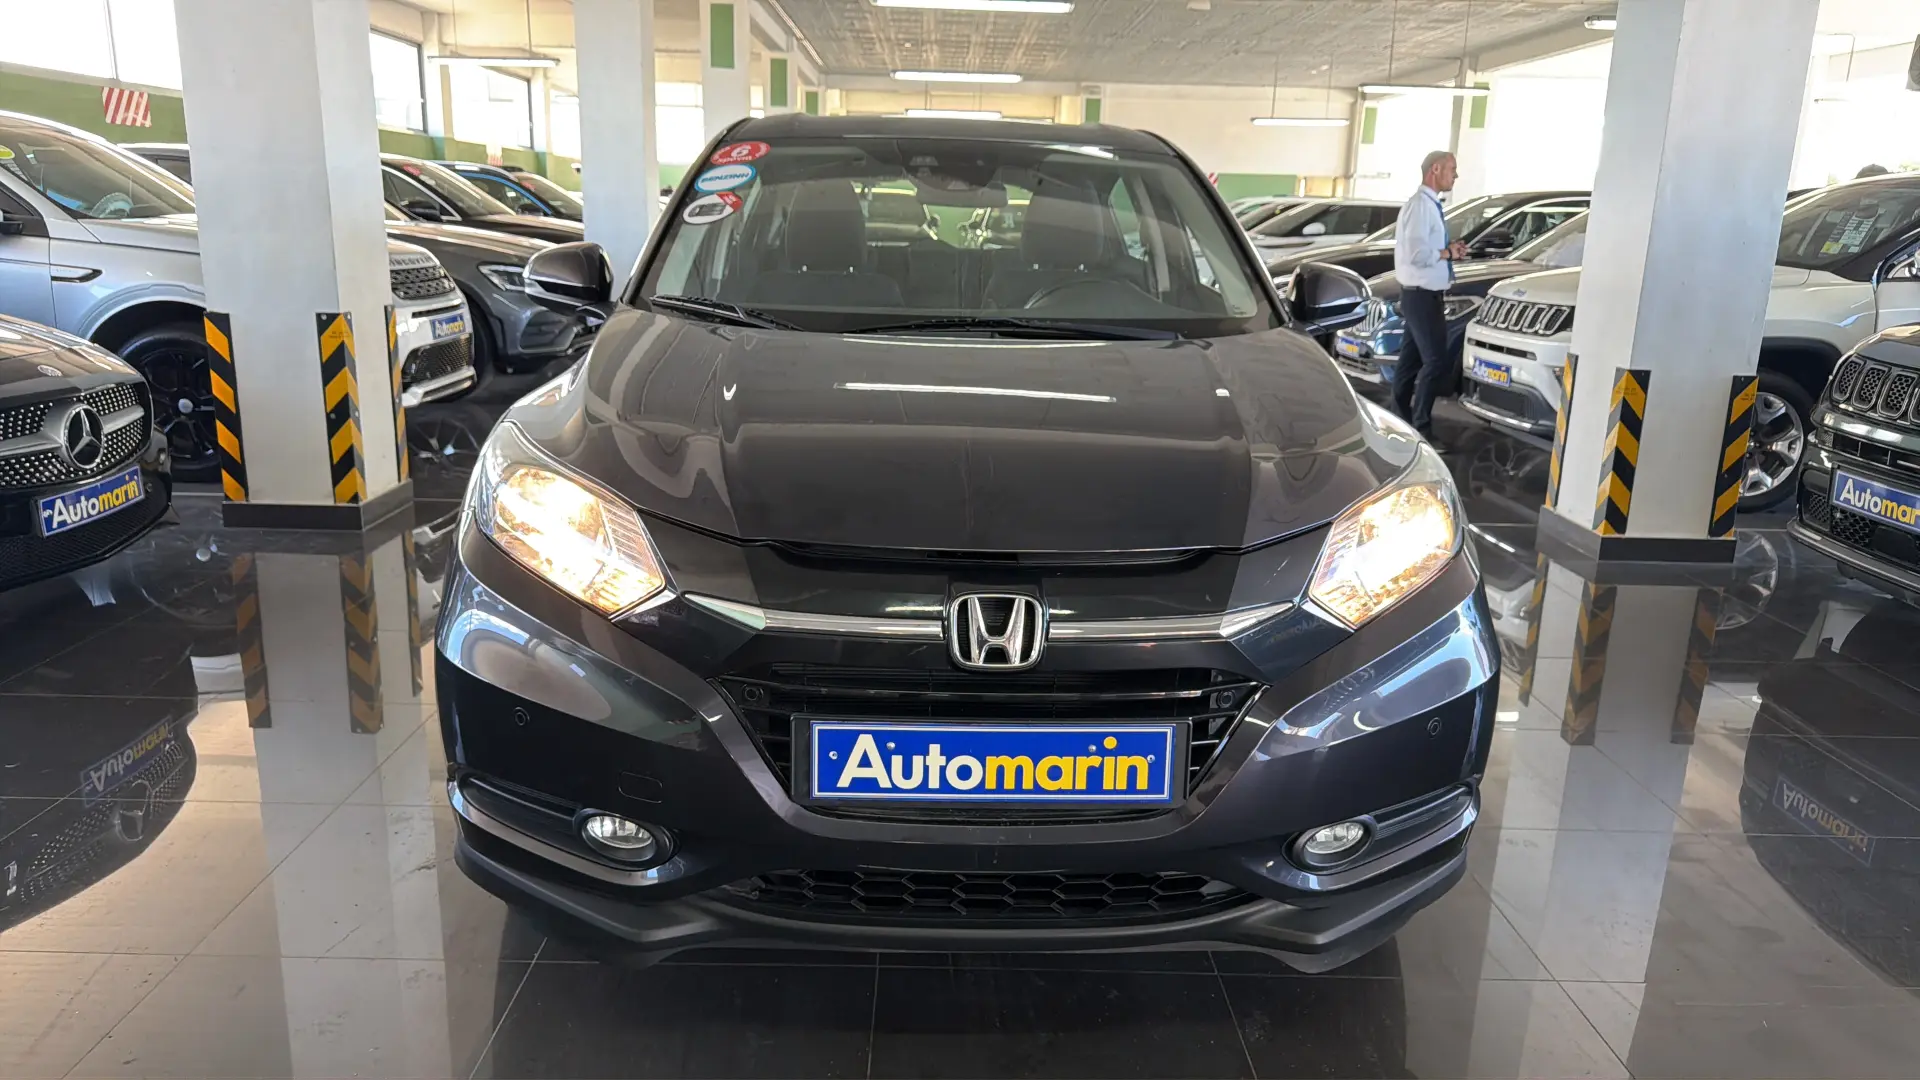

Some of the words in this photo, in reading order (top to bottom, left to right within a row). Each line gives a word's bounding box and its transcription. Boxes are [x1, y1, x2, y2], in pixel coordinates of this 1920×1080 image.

[52, 474, 139, 529] Automarin
[1840, 478, 1920, 525] Automar
[836, 733, 1148, 791] Automarin
